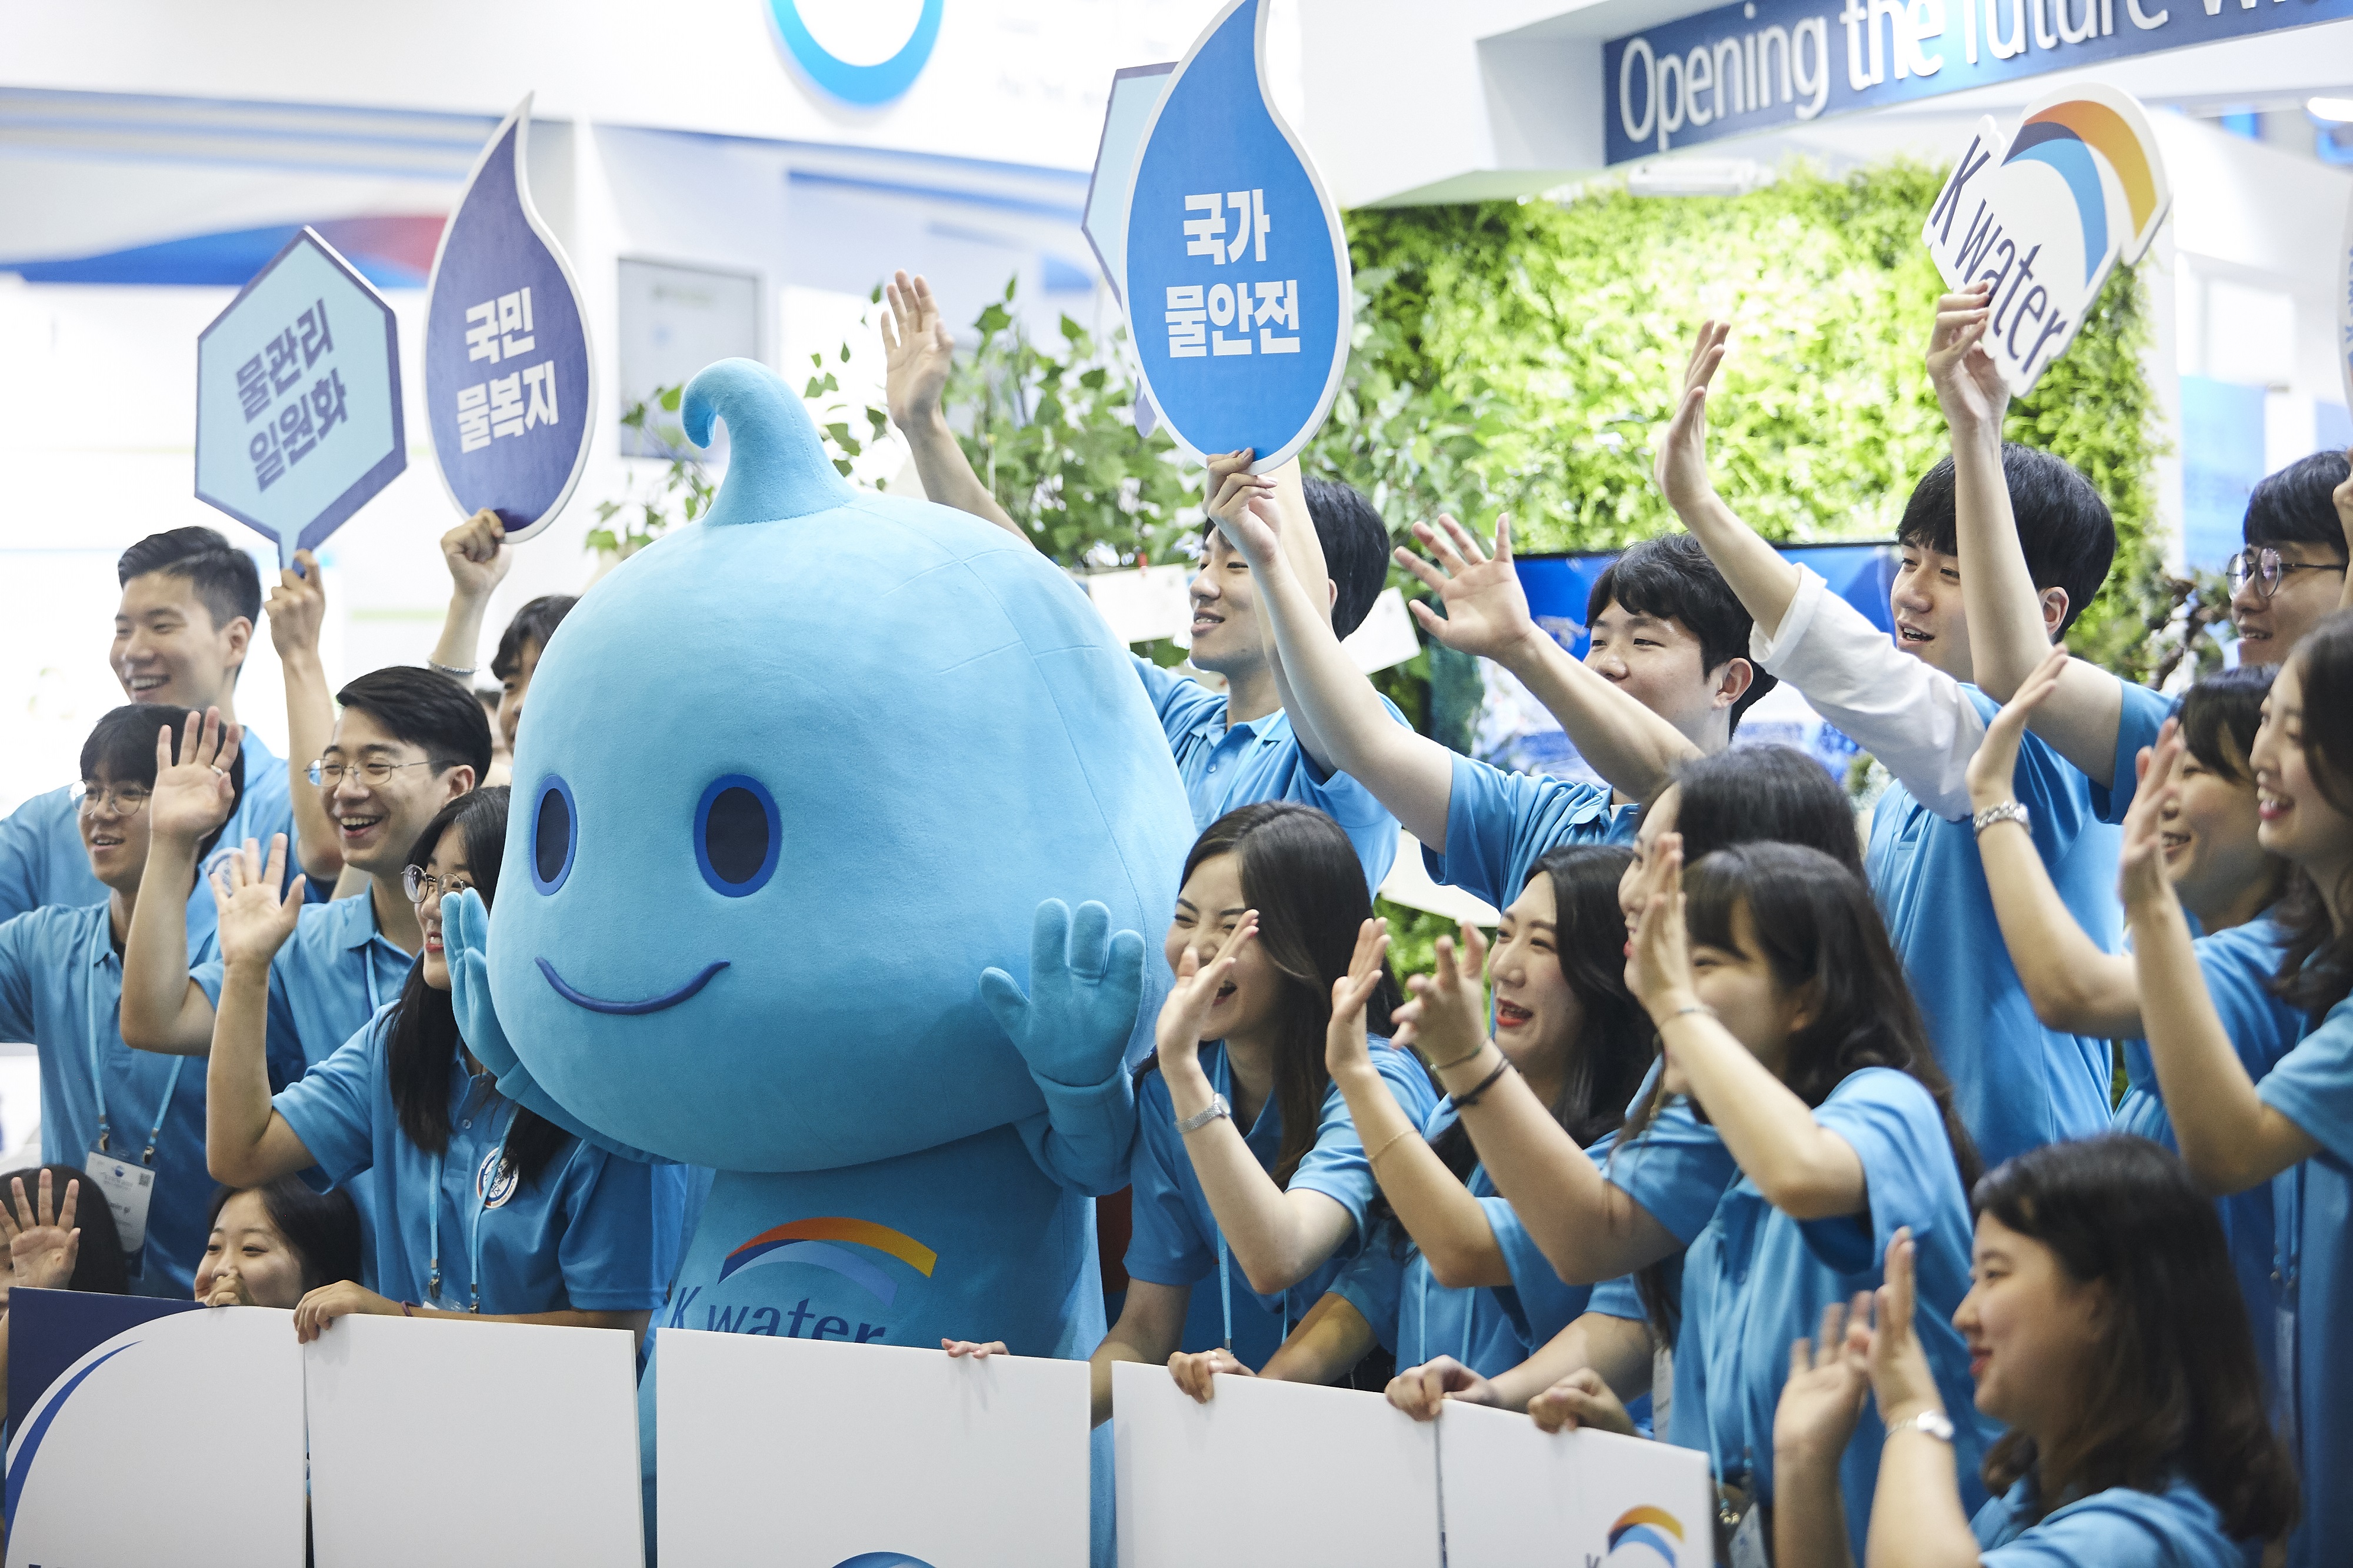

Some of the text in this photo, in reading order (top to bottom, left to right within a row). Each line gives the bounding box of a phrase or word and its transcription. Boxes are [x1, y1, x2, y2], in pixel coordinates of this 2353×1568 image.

[1619, 2, 1829, 151] Opening
[1839, 0, 1945, 91] the
[1184, 189, 1270, 265] 국가
[1932, 134, 2067, 374] K water
[236, 298, 334, 424] 물관리
[466, 286, 535, 364] 국민
[1165, 280, 1300, 358] 물안전
[249, 368, 348, 493] 일원화
[456, 360, 558, 453] 물복지
[669, 1286, 702, 1329] K
